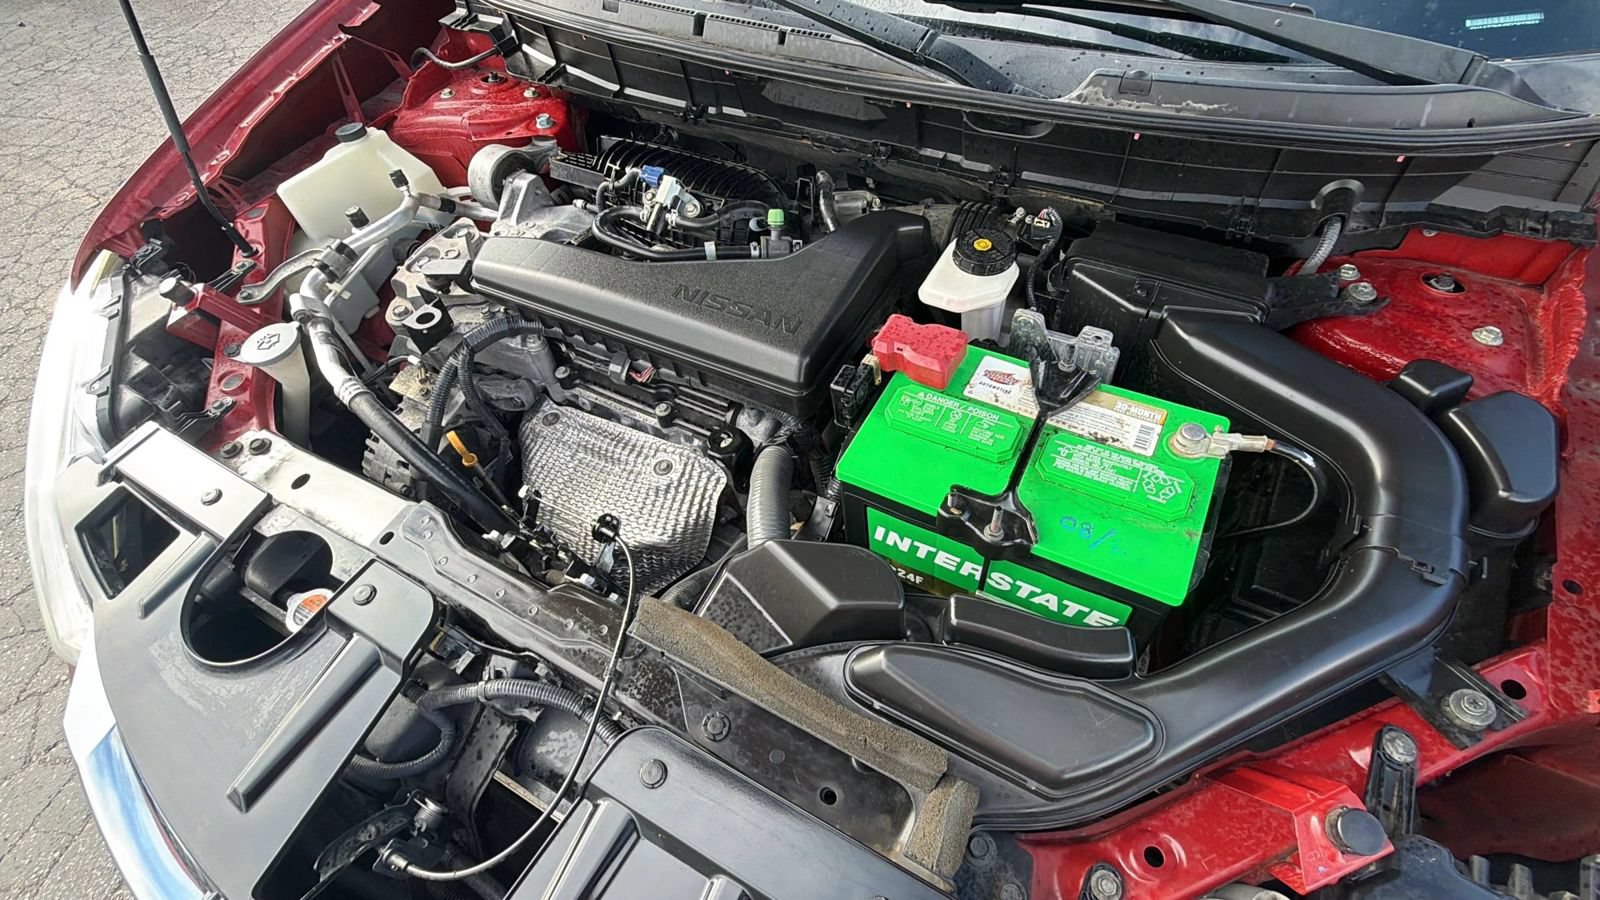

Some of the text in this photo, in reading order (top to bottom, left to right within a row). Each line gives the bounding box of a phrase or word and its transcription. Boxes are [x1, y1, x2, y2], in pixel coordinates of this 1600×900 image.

[671, 283, 803, 336] NISSAN
[926, 393, 960, 408] DANGER
[967, 406, 1000, 422] POISON
[889, 564, 924, 584] 24F
